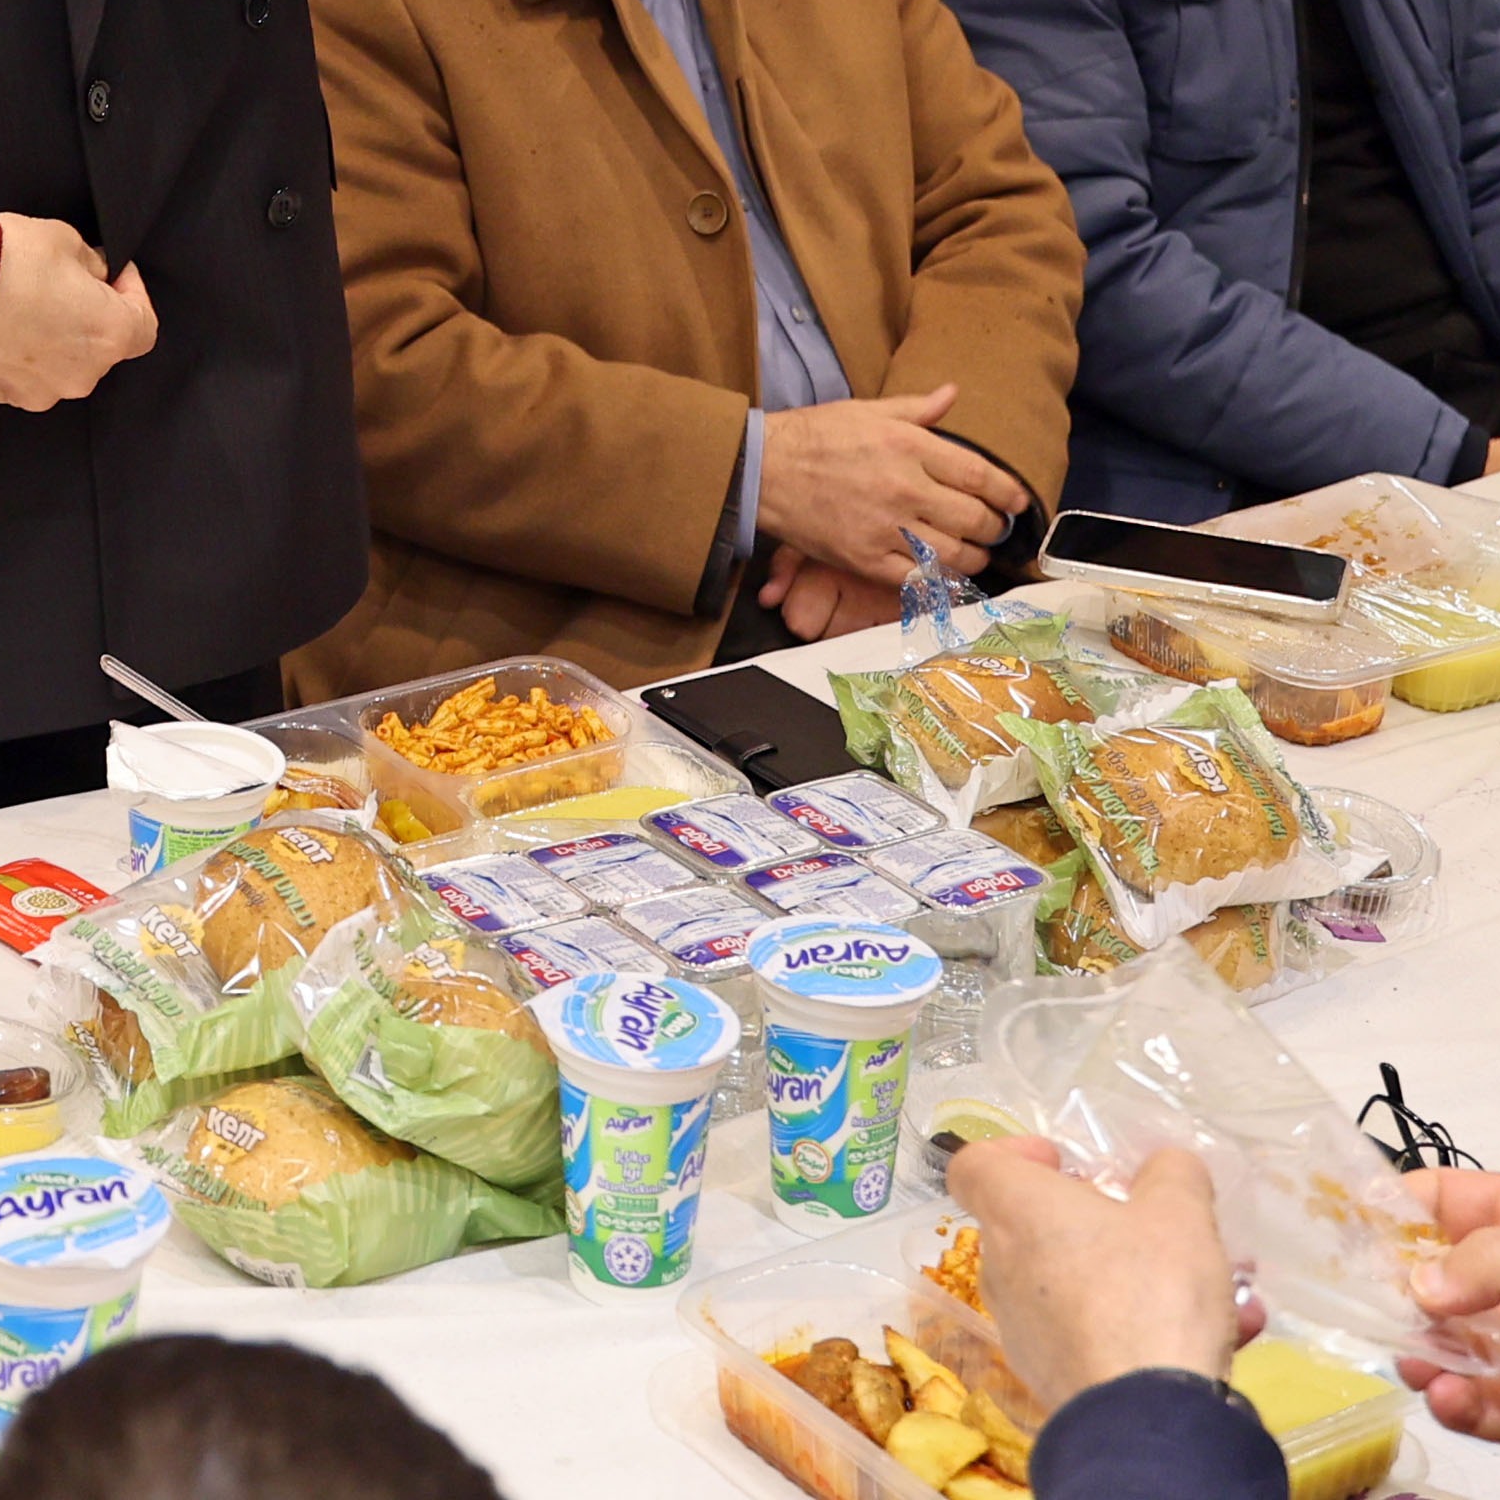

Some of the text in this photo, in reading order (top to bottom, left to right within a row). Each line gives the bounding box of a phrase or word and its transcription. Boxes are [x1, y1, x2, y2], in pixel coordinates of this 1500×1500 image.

[1187, 748, 1230, 793] Ken
[800, 806, 843, 836] Dalga
[554, 839, 606, 856] Dalga
[680, 825, 723, 855] Dalga
[770, 860, 822, 880] Dalga
[966, 871, 1019, 895] Dalga
[274, 873, 317, 928] UNLU
[441, 886, 487, 918] Dalga
[709, 936, 748, 956] alga
[784, 939, 911, 971] Ayran
[616, 980, 676, 1052] Ayran
[767, 1073, 823, 1103] yran
[604, 1114, 654, 1134] Ayran
